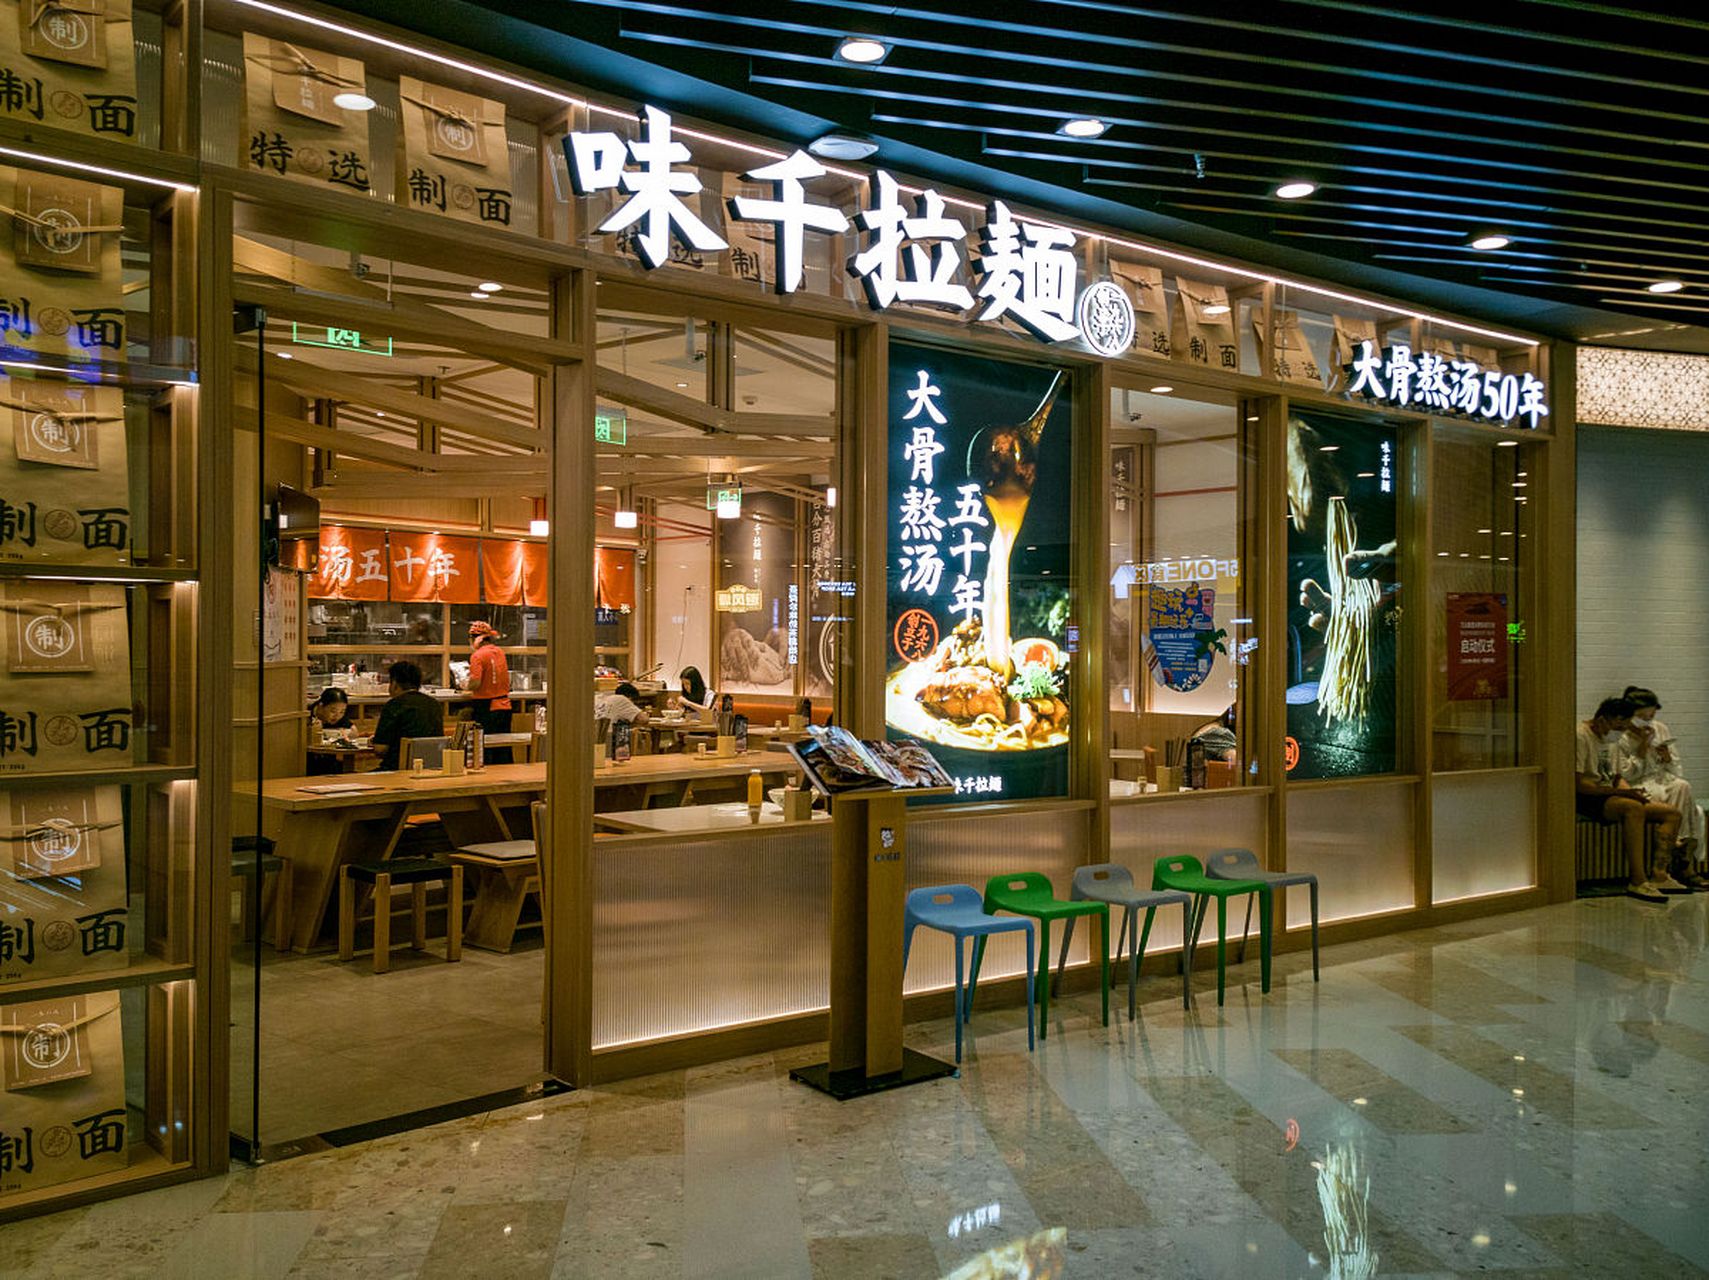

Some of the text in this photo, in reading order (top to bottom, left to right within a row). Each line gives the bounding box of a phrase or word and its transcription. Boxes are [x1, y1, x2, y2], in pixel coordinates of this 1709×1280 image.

[1350, 340, 1550, 430] 大骨熬汤50年
[899, 369, 948, 598] 大骨熬汤
[947, 483, 989, 624] 五十年
